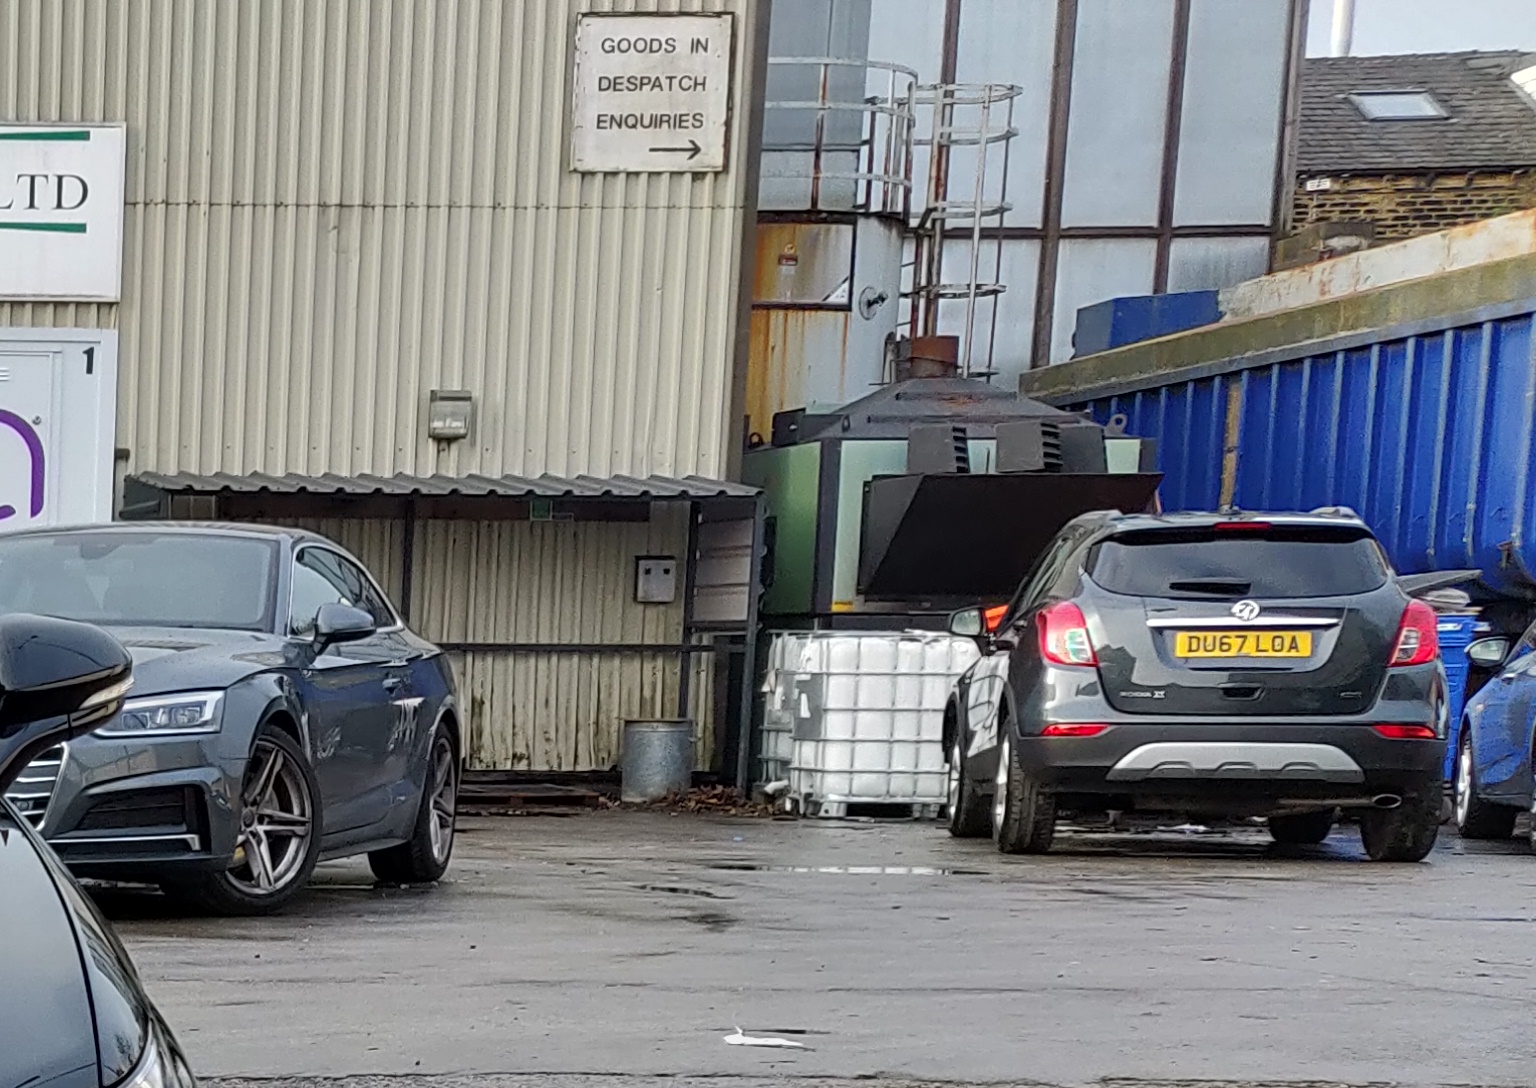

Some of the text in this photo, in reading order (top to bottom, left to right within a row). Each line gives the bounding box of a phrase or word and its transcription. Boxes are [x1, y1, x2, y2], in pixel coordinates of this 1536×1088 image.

[601, 37, 709, 55] GOODS IN
[598, 75, 707, 92] DESPATCH
[596, 113, 704, 130] ENQUIRIES
[82, 346, 95, 375] 1
[1187, 635, 1300, 653] DU67 LOA
